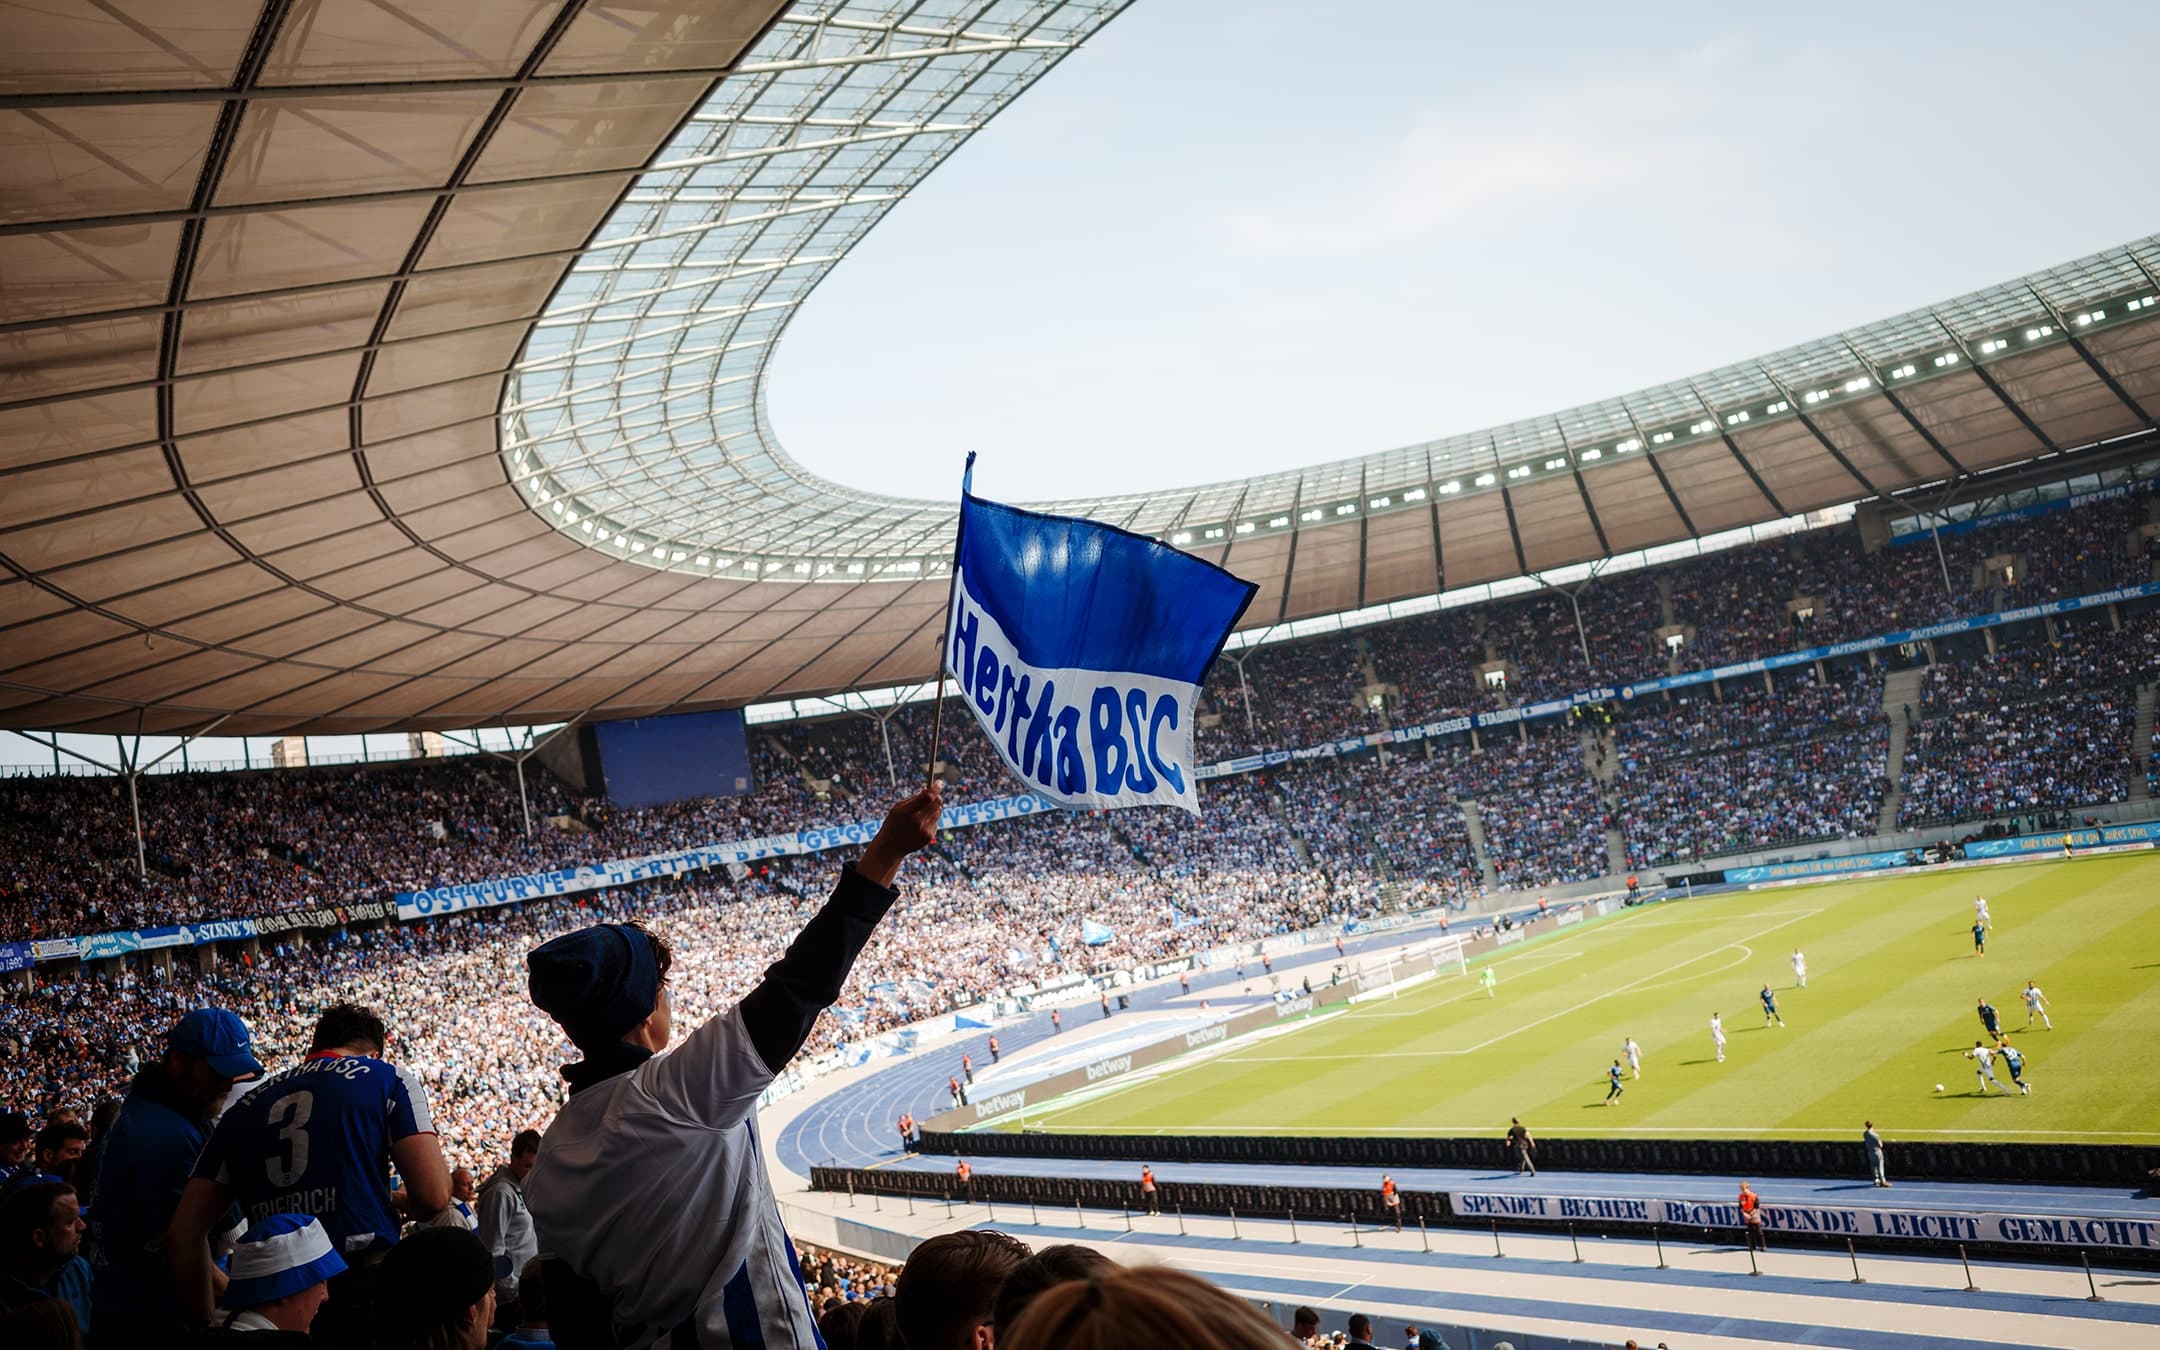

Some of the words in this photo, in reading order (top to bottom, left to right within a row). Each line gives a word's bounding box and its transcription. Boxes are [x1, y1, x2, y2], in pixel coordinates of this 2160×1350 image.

[1910, 621, 1970, 639] AUTOHERO
[1828, 637, 1886, 655] AUTOHERO
[953, 589, 1087, 796] Hertha
[1090, 685, 1185, 796] BSC
[1393, 716, 1472, 743] BLAU-WEISSES
[1478, 708, 1521, 727] STADION
[803, 821, 881, 850] GEGE
[413, 871, 565, 914] OSTKURVE
[1275, 996, 1314, 1017] betway
[1186, 1023, 1228, 1047] betway
[1086, 1055, 1132, 1080] betway
[975, 1090, 1026, 1118] betway
[265, 1090, 314, 1187] 3
[1462, 1194, 1547, 1215] SPENDET
[1560, 1198, 1648, 1220] BECHER!
[1872, 1213, 1979, 1240] LEICHT
[1999, 1217, 2155, 1247] GEMACHT
